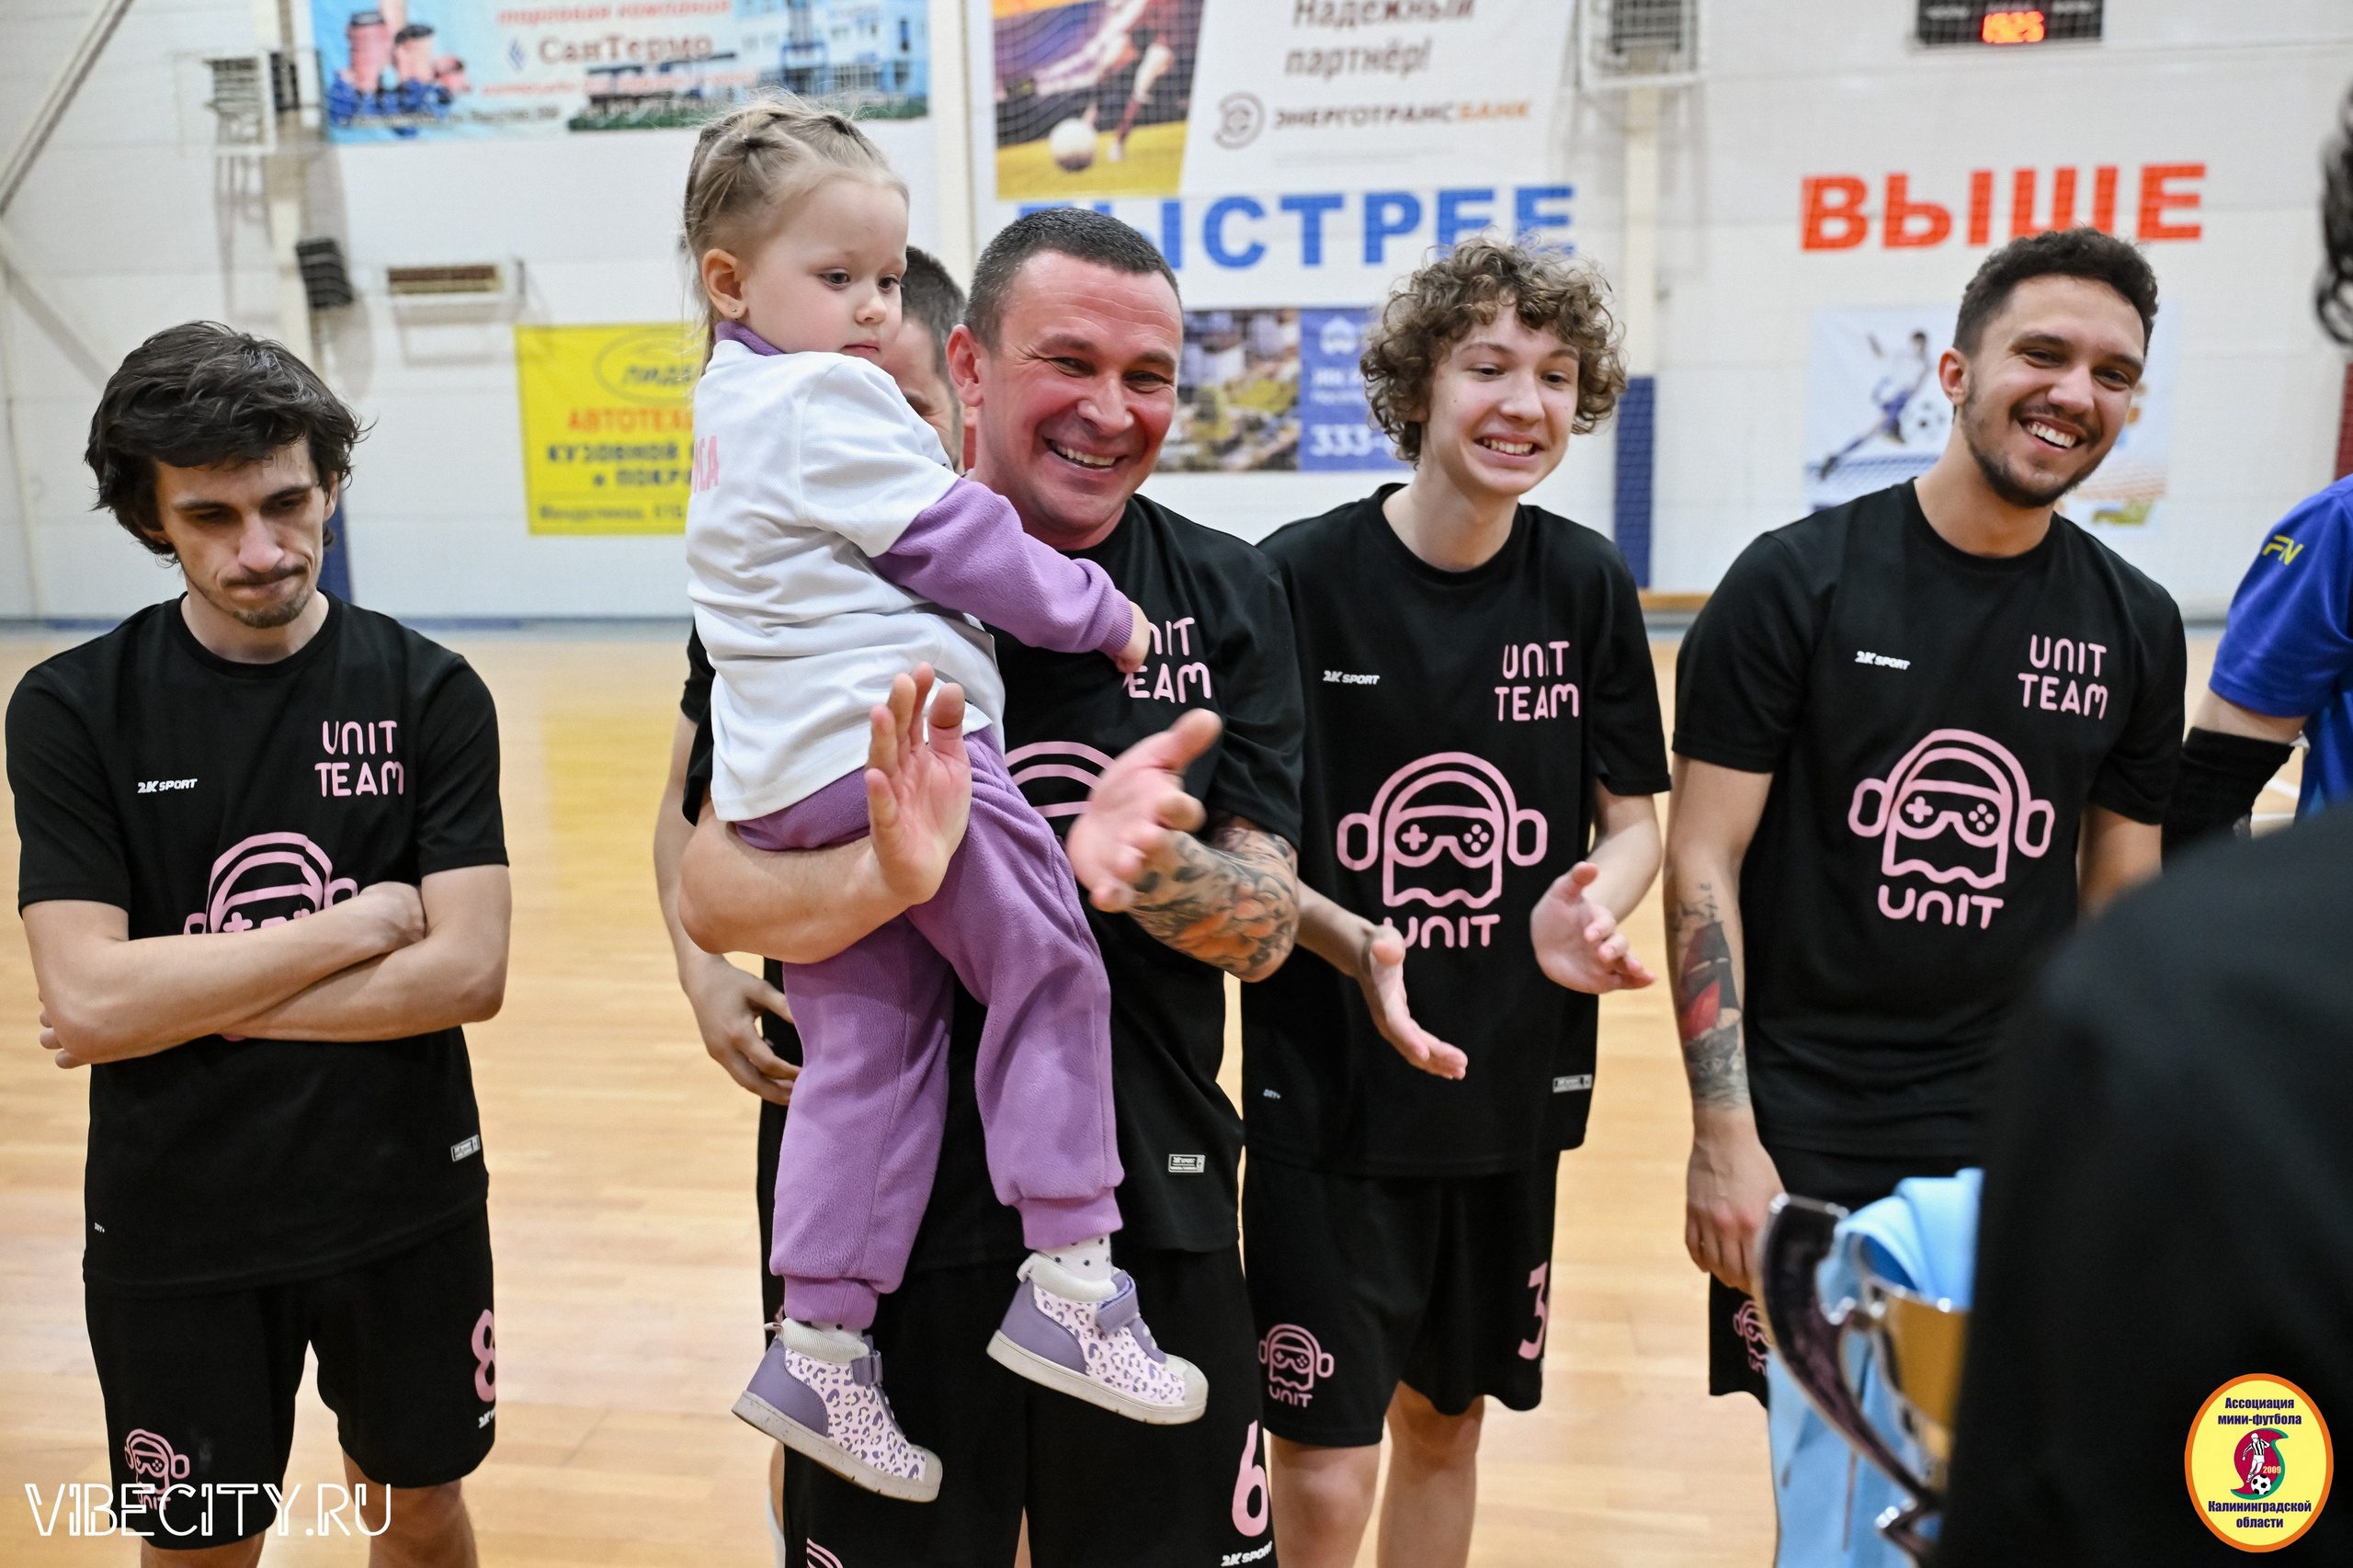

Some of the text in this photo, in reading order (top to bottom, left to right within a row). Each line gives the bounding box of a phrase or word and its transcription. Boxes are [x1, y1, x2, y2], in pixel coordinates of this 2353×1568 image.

[1801, 163, 2207, 252] ВЫШЕ
[1149, 617, 1195, 656] NIT
[2029, 634, 2108, 677] UNIT
[1323, 670, 1381, 686] 2K SPORT
[1503, 641, 1570, 679] UNIT
[1123, 662, 1212, 703] EAM
[2018, 672, 2109, 720] TEAM
[1495, 683, 1580, 722] TEAM
[323, 721, 397, 755] UNIT
[137, 778, 198, 793] 2K SPORT
[314, 761, 404, 798] TEAM
[1878, 884, 2005, 930] UNIT
[1518, 1260, 1551, 1360] 3
[471, 1308, 495, 1403] 8
[1268, 1384, 1313, 1408] UNIT
[1232, 1419, 1268, 1537] 6
[1221, 1551, 1243, 1567] 2K
